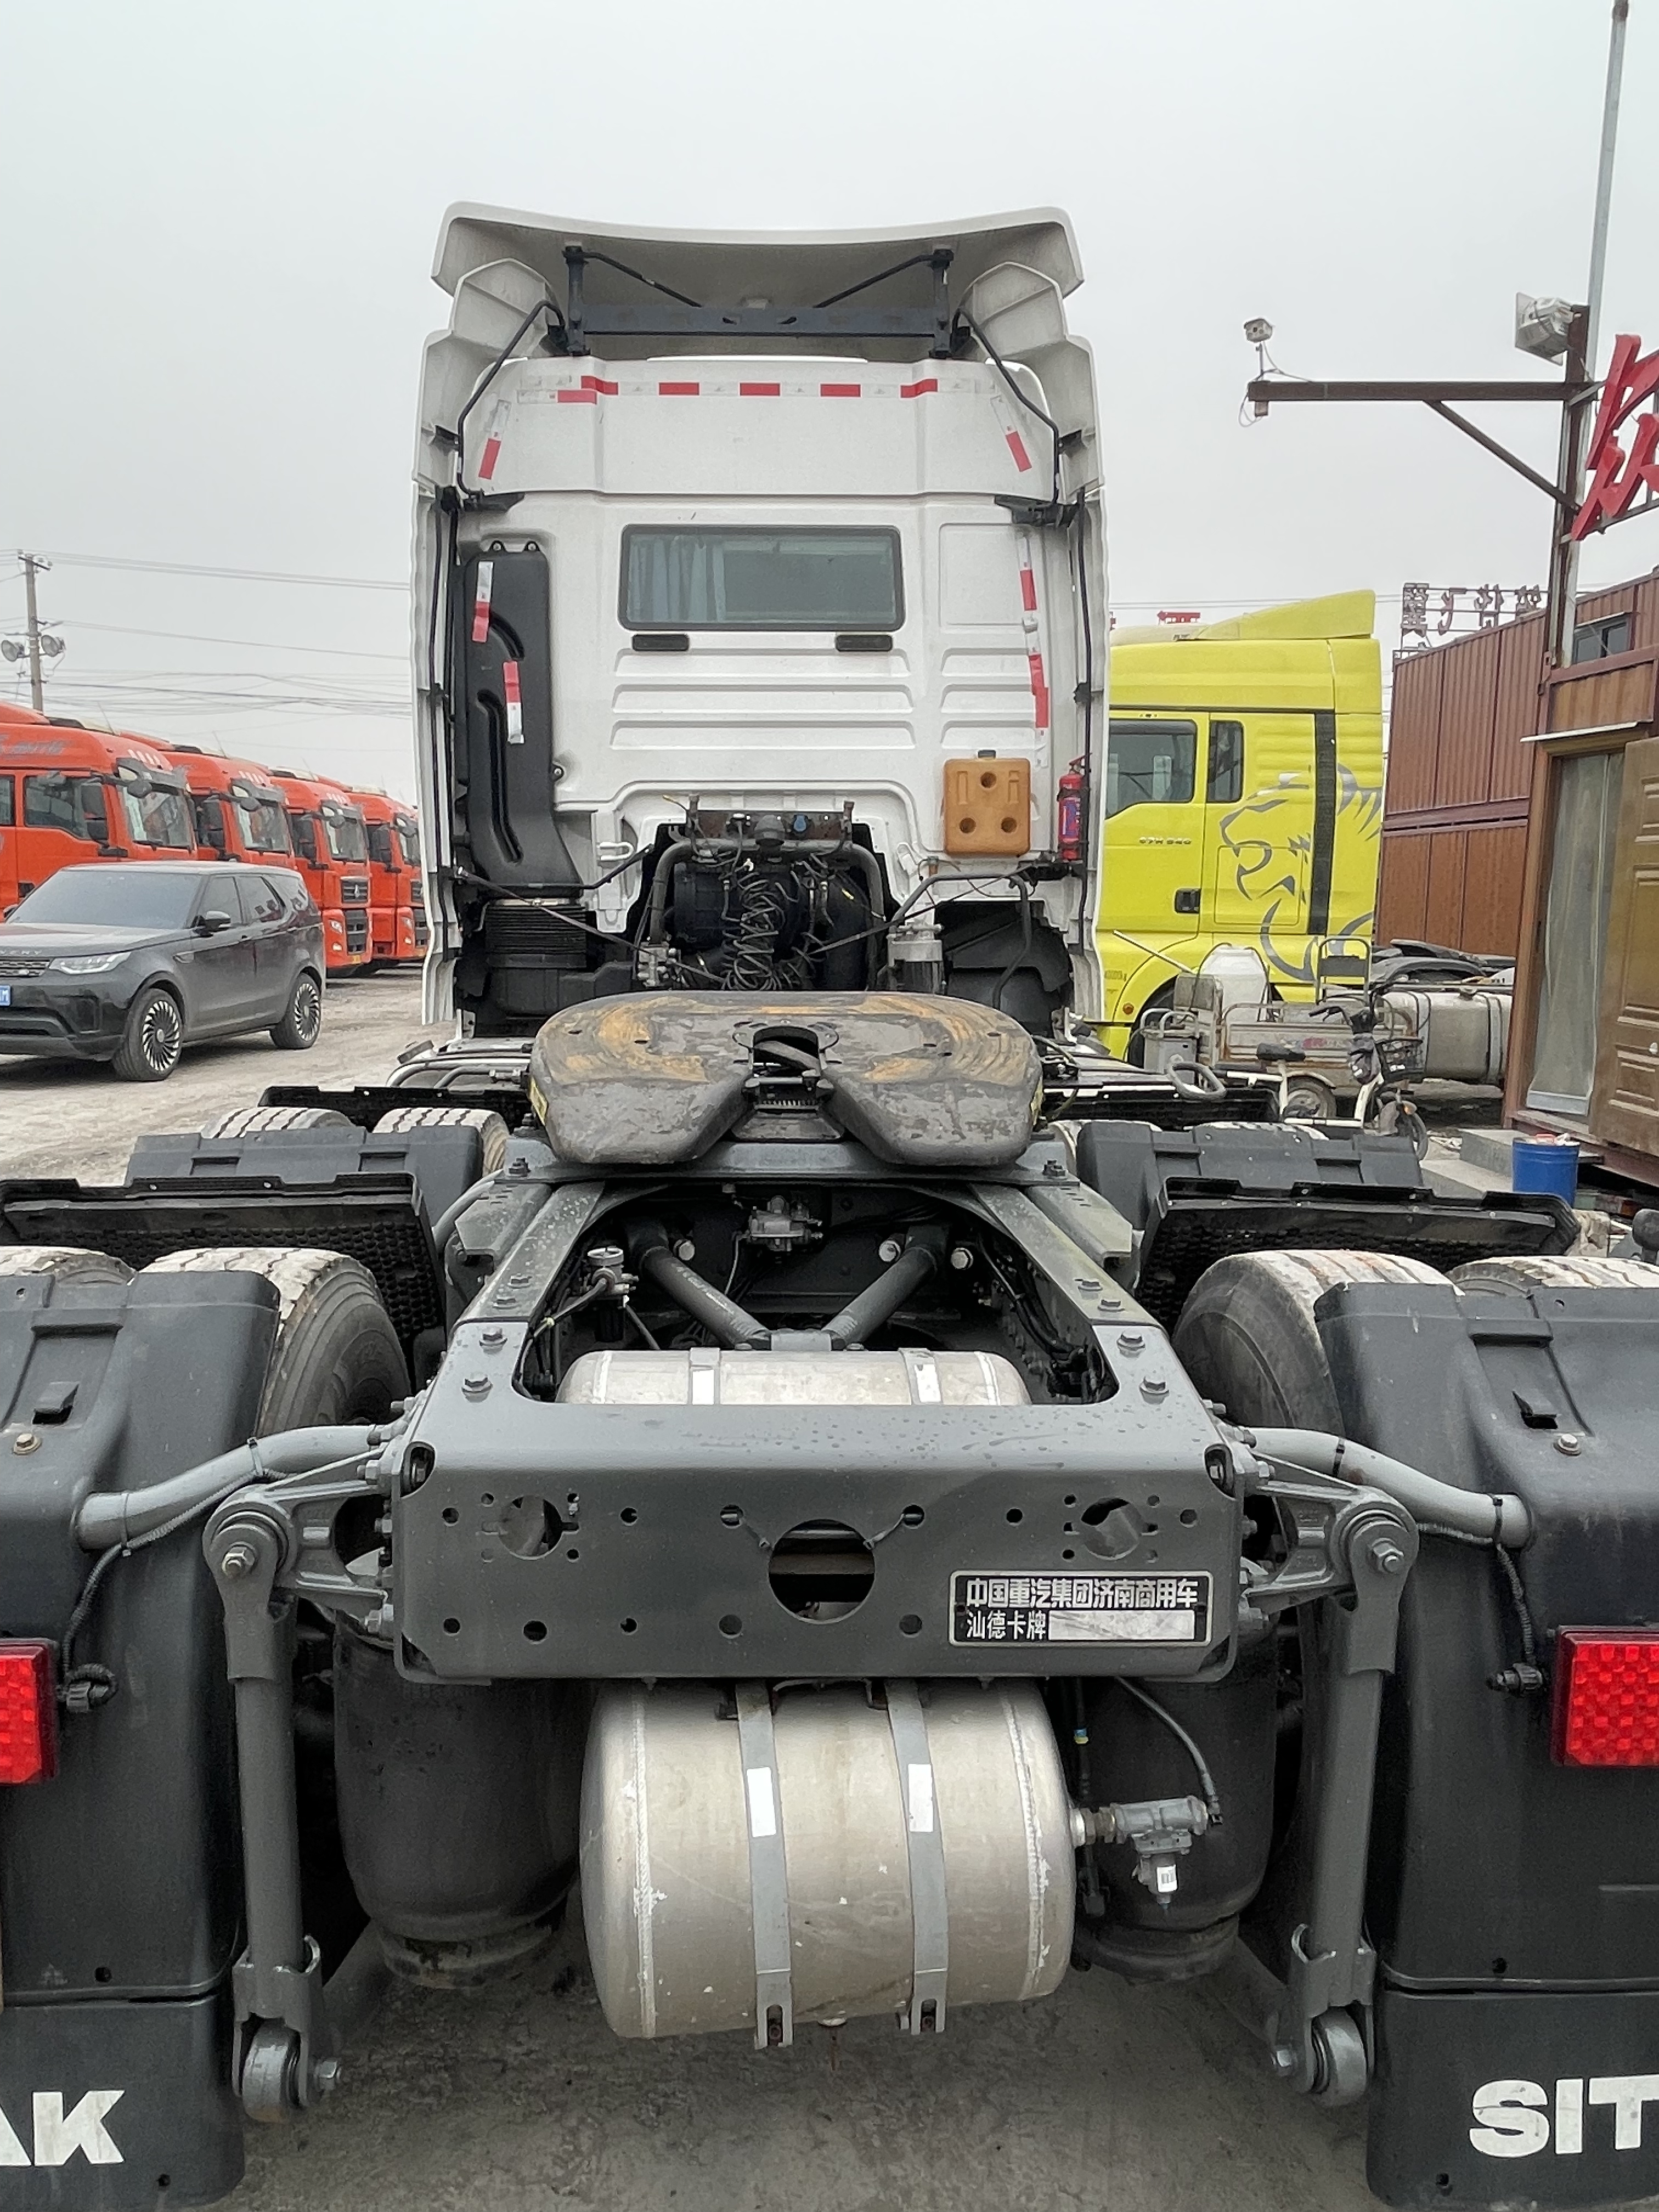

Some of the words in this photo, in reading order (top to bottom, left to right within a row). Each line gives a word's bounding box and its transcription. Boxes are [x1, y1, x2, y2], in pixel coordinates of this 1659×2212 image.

[967, 1578, 1198, 1609] 中国重汽集团济南商用车
[967, 1610, 1047, 1640] 汕德卡牌
[1469, 2074, 1659, 2158] SIT
